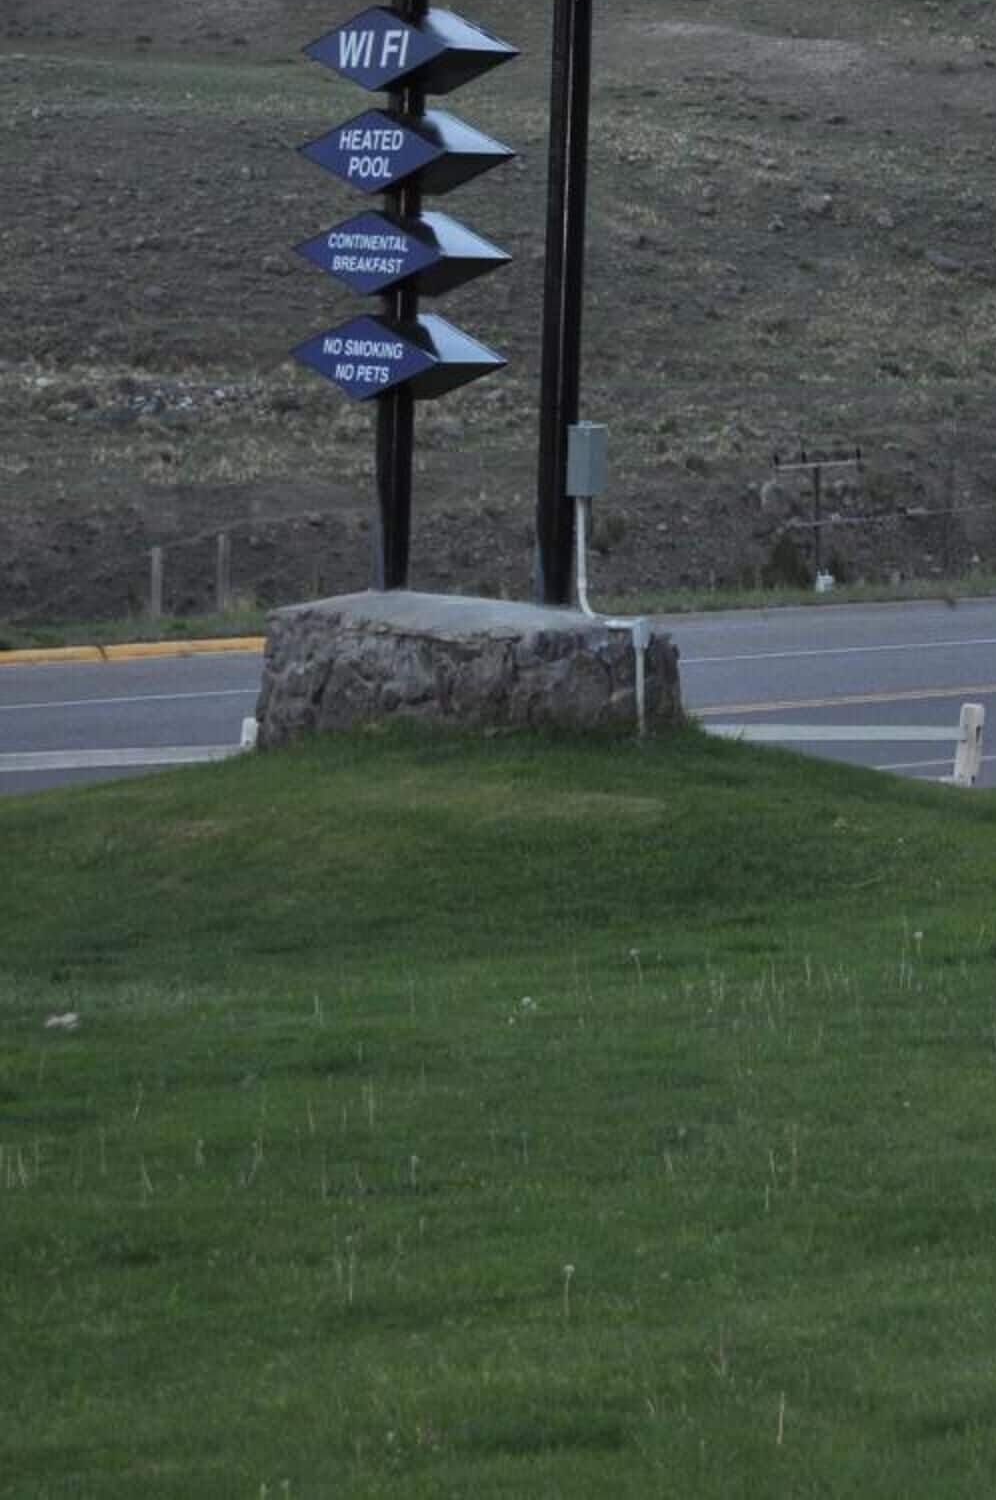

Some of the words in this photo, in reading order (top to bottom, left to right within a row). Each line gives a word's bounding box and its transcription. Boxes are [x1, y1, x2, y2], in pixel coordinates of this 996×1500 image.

[339, 29, 375, 68] WI
[380, 29, 410, 68] FI
[339, 129, 404, 151] HEATED
[347, 155, 393, 178] POOL
[328, 232, 409, 252] CONTINENTAL
[332, 255, 404, 275] BREAKFAST
[323, 337, 343, 355] NO
[344, 338, 404, 360] SMOKING
[335, 363, 355, 381] NO
[356, 364, 390, 384] PETS
